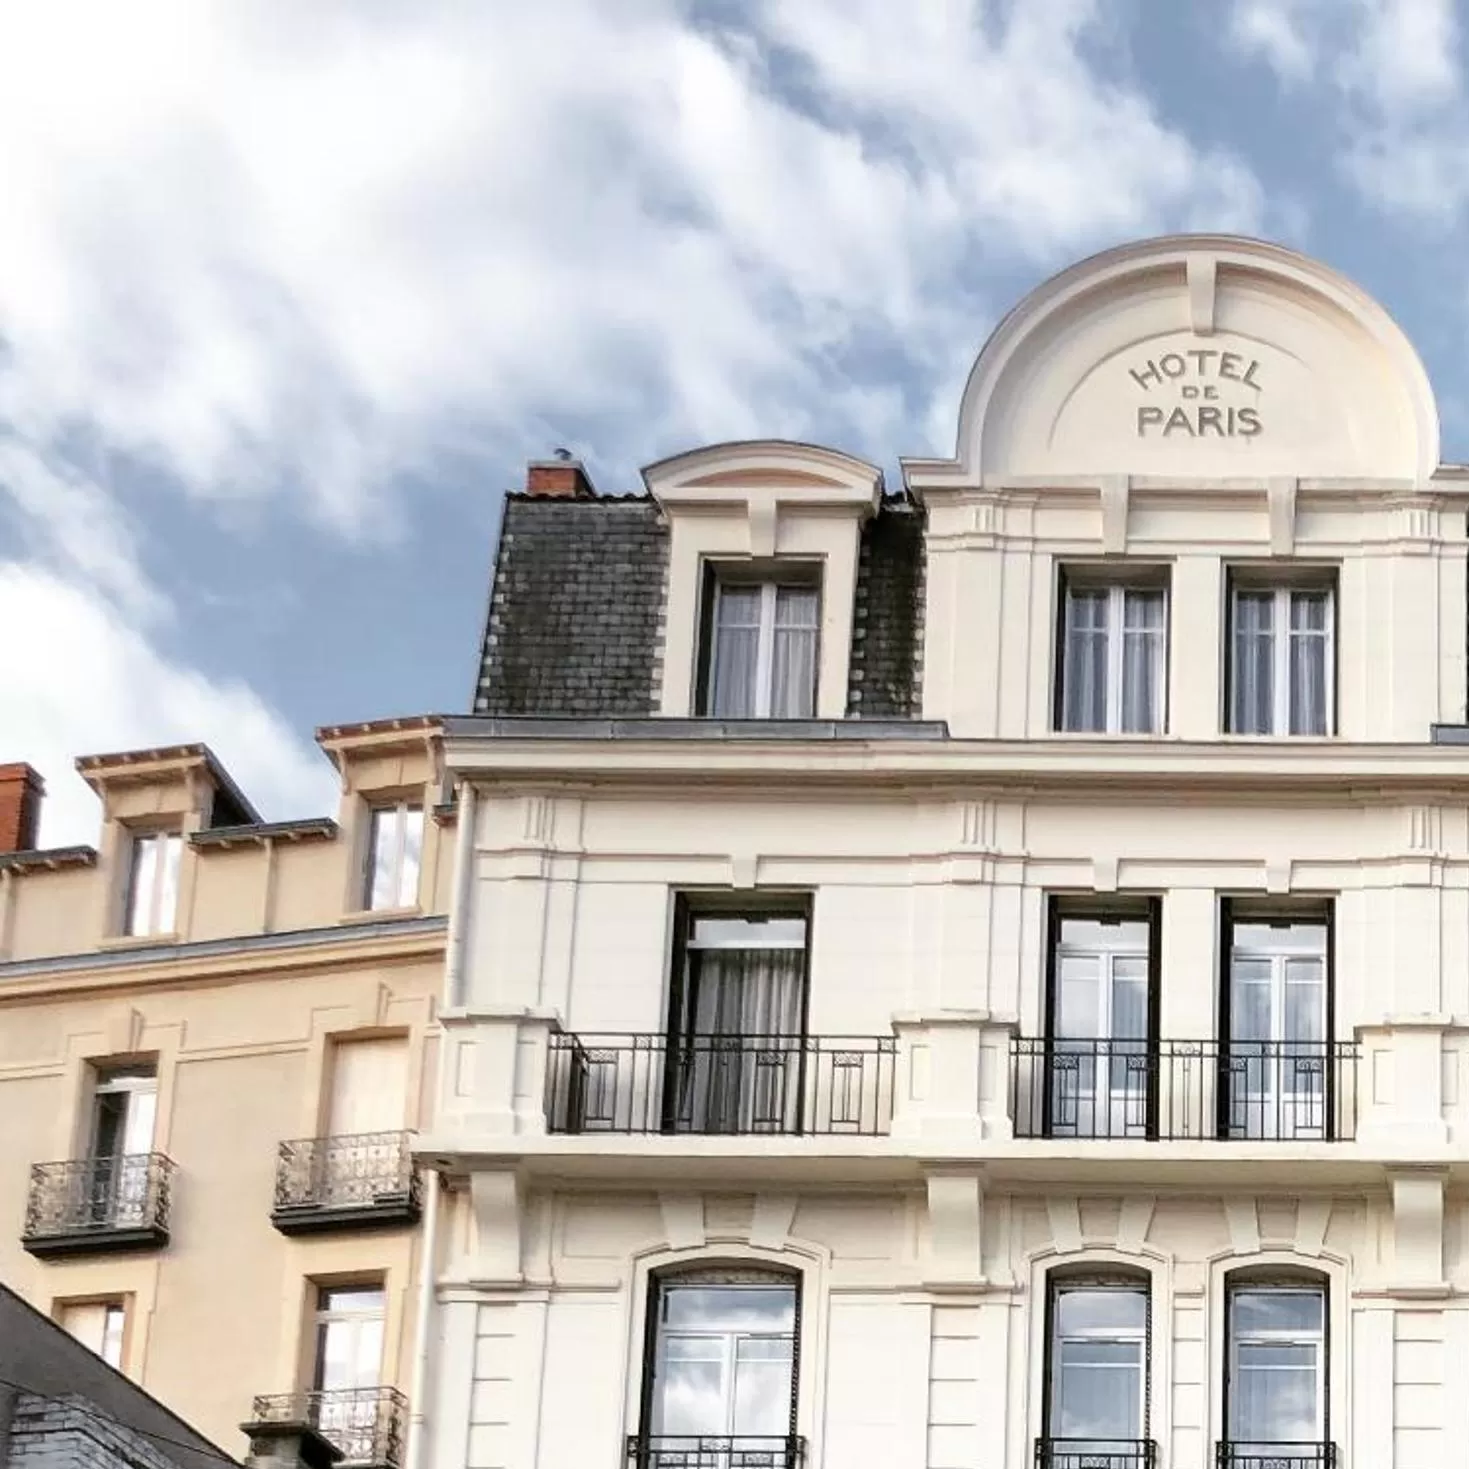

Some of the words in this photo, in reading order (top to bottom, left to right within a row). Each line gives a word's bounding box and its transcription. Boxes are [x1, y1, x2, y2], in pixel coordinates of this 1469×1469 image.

[1128, 350, 1263, 392] HOTEL
[1181, 385, 1220, 400] DE
[1137, 406, 1264, 438] PARIS
